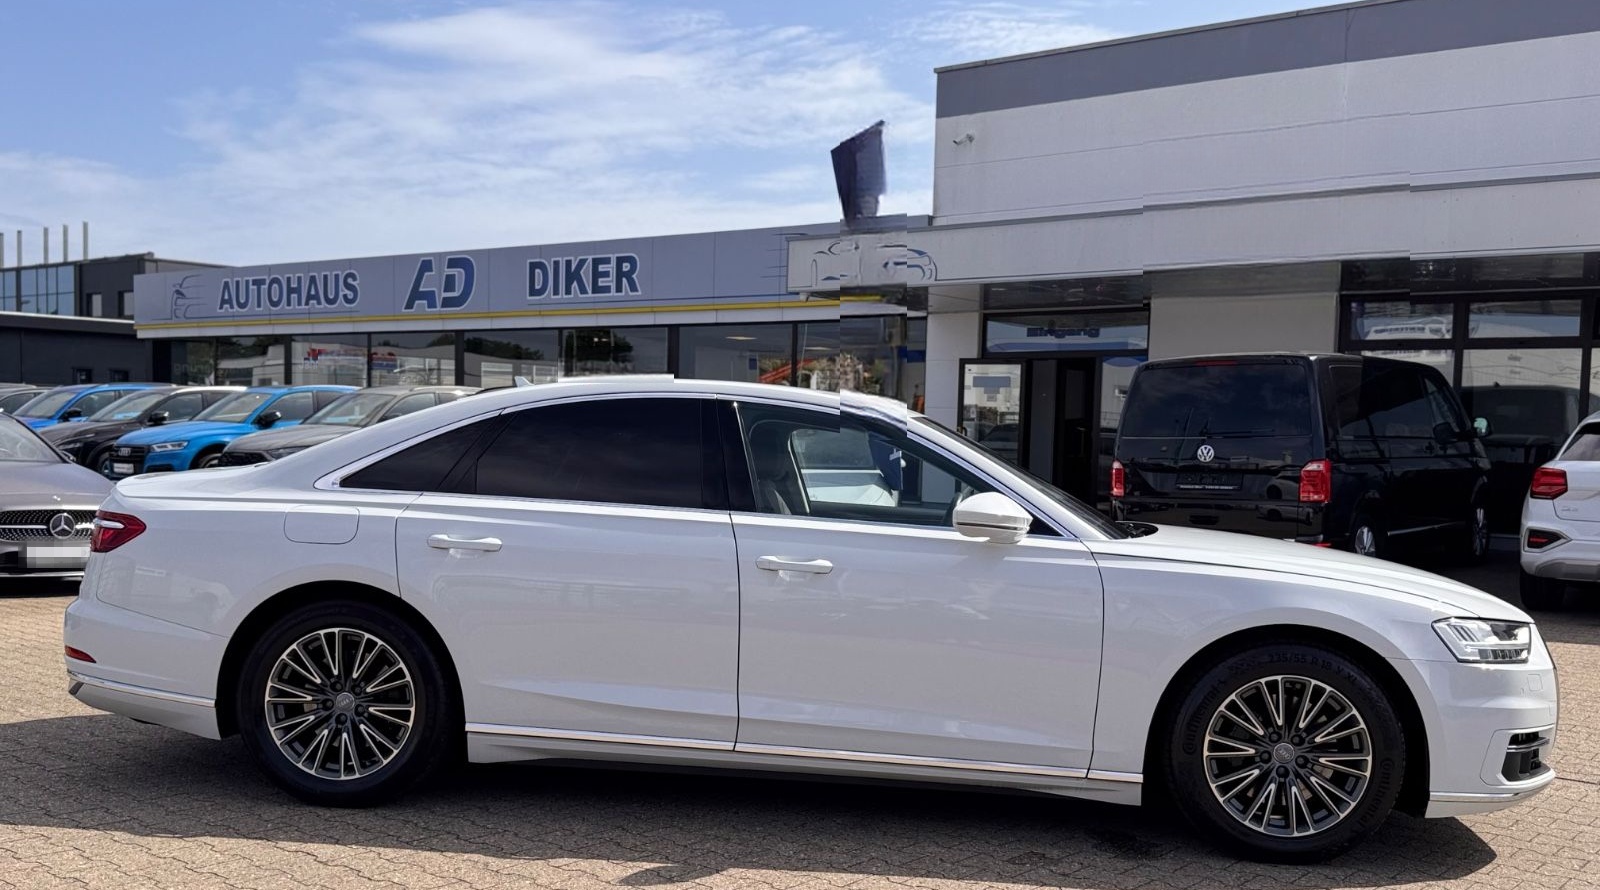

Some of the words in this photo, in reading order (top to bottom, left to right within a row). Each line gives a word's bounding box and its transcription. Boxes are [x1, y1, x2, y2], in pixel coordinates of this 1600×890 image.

[218, 270, 360, 312] AUTOHAUS
[402, 255, 476, 312] AD
[526, 253, 642, 299] DIKER
